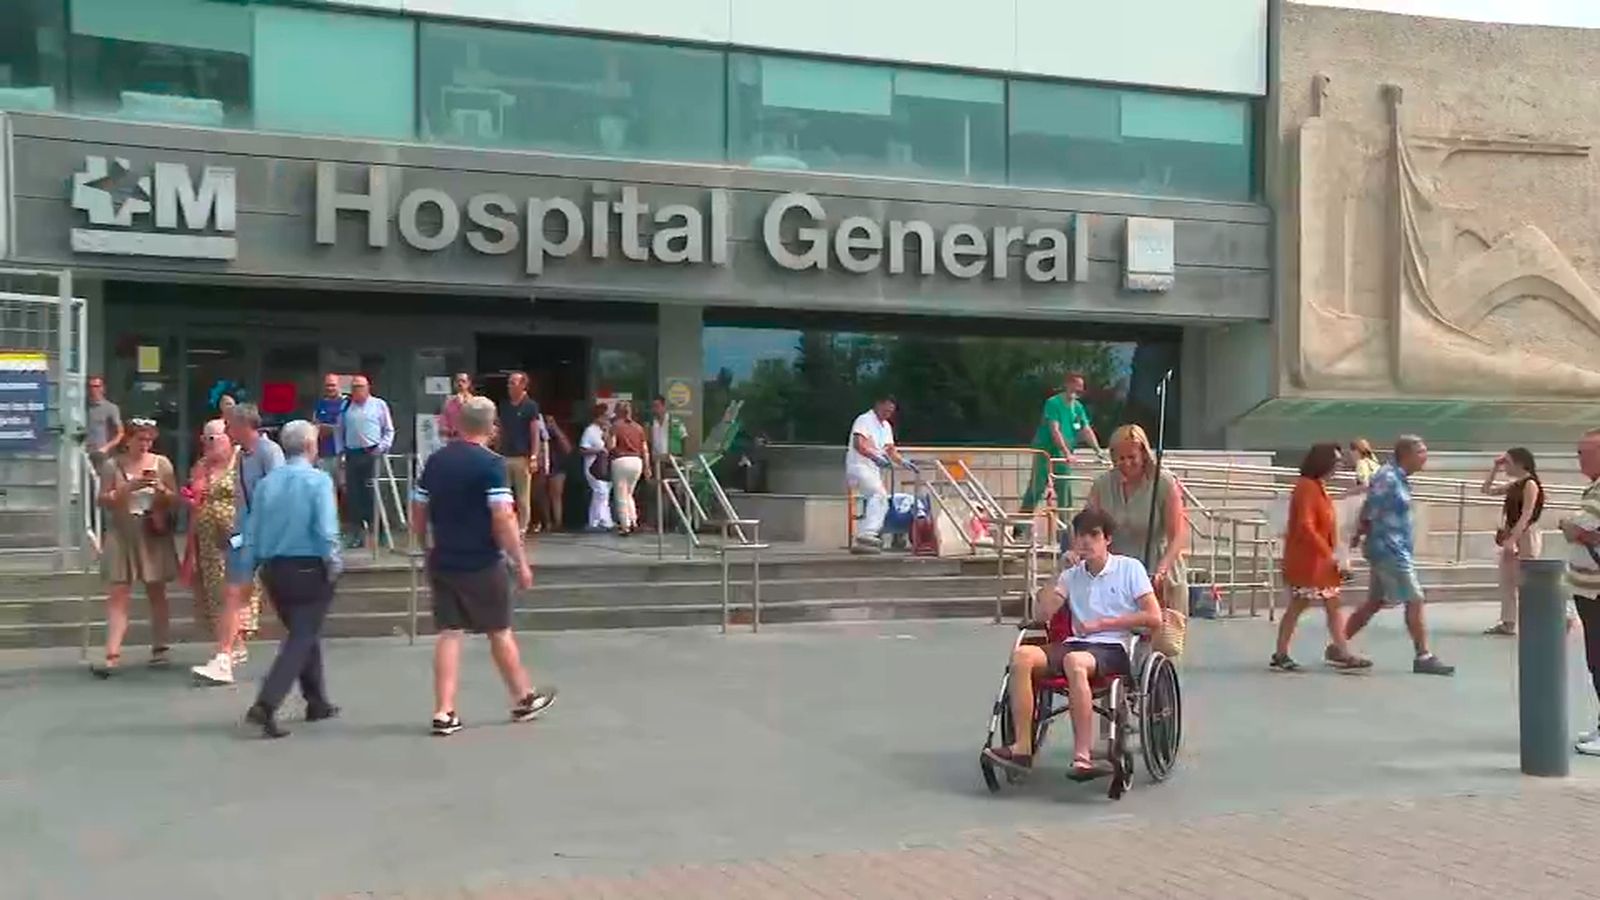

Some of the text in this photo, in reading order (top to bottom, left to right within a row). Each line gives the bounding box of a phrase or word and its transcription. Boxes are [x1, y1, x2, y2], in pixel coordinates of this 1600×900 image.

[155, 163, 237, 231] M
[315, 162, 1089, 282] Hospital General
